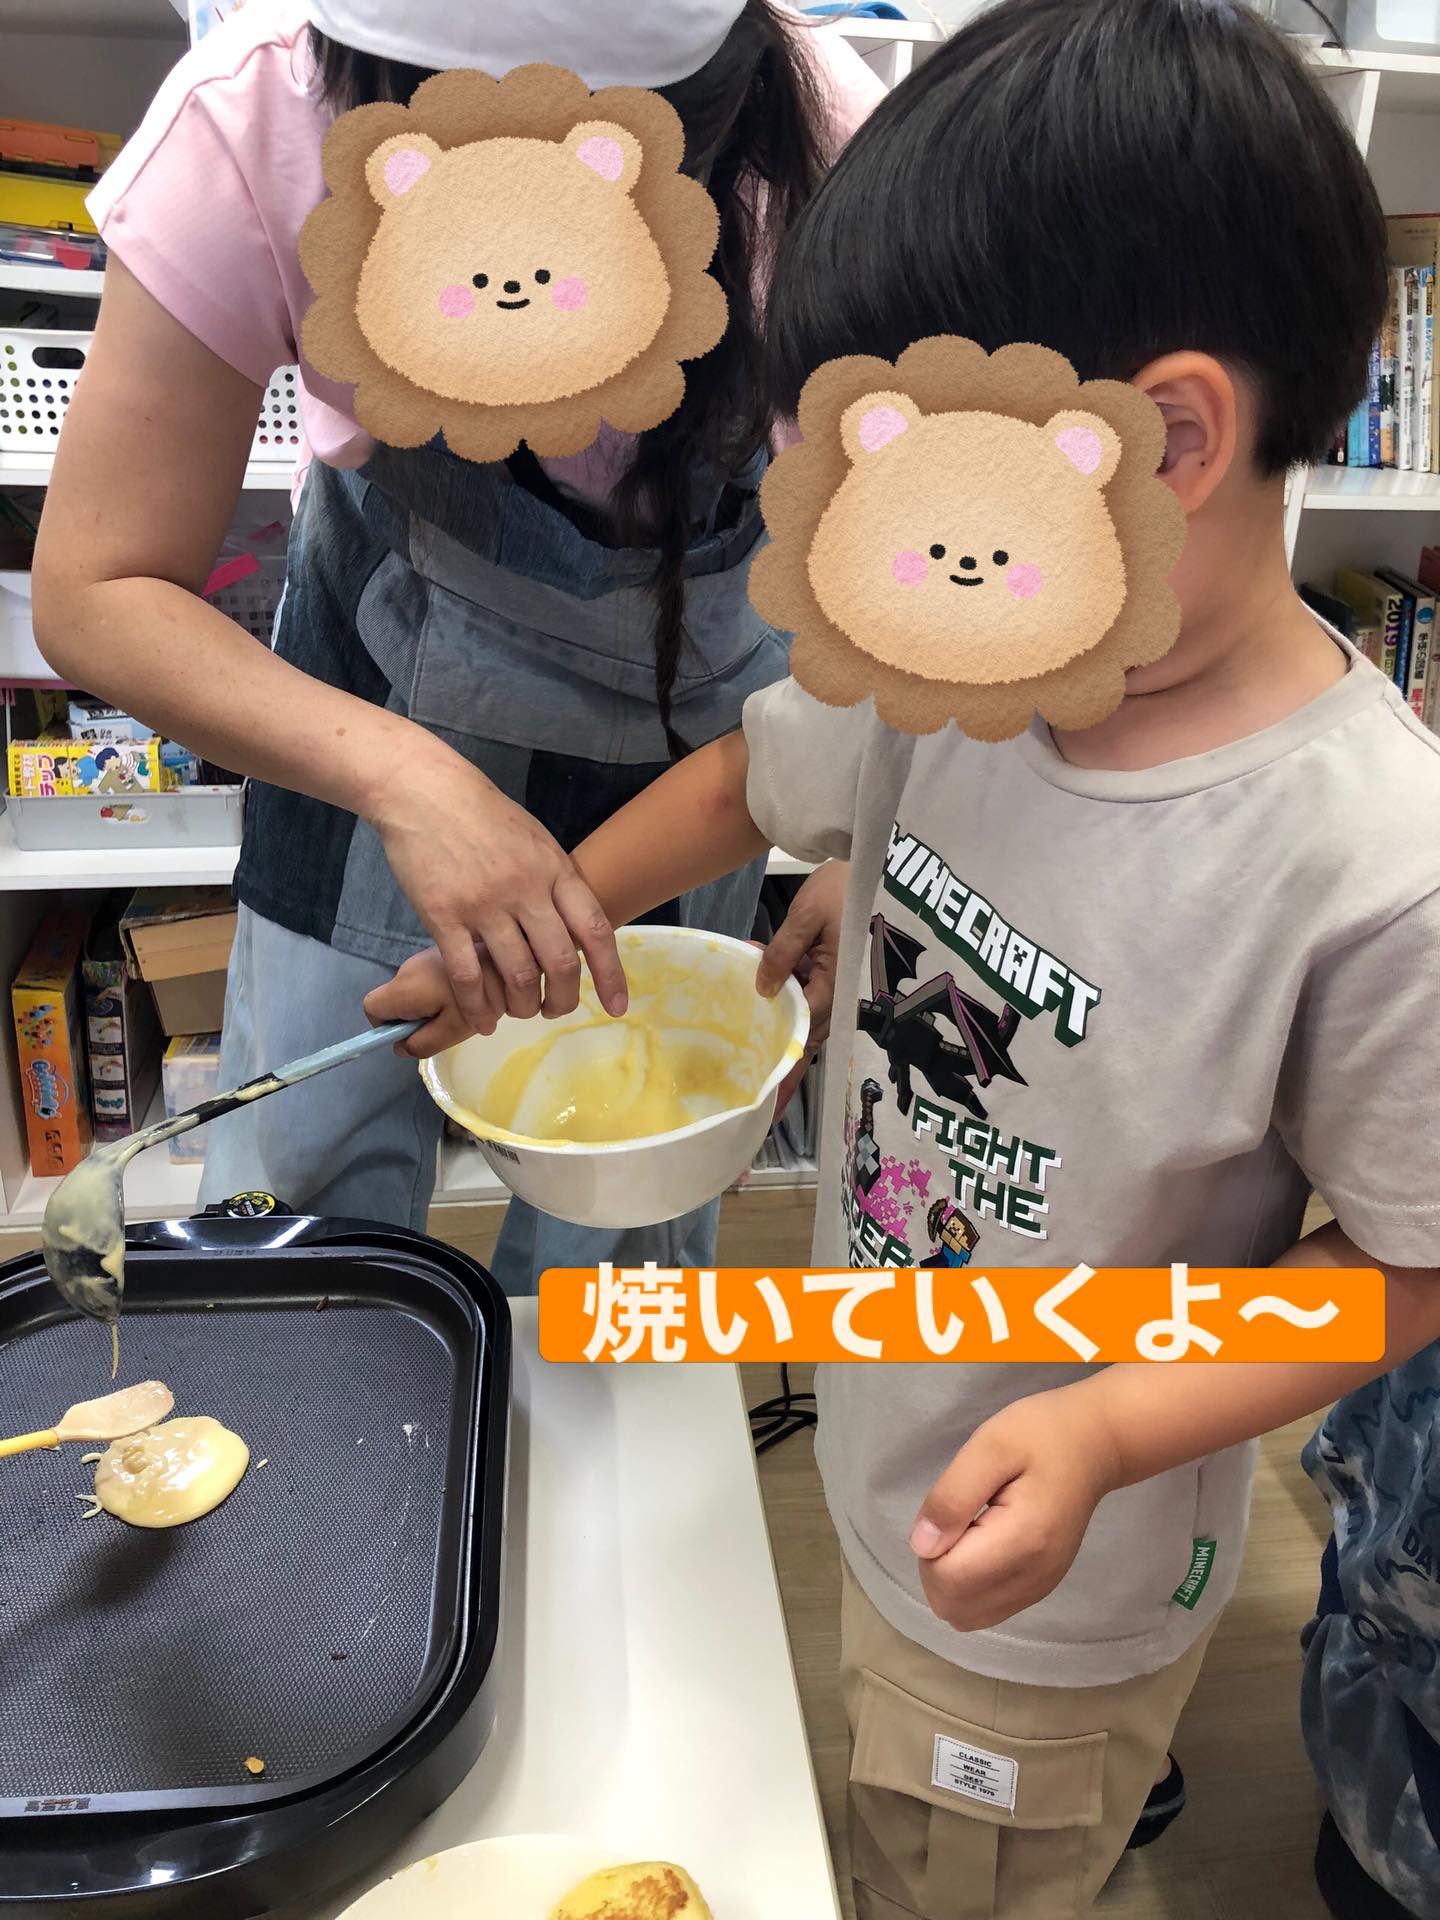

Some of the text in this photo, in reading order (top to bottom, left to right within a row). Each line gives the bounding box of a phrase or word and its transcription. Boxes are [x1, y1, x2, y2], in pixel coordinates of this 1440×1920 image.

[912, 1095, 1062, 1191] FIGHT
[948, 1158, 1049, 1240] THE
[1177, 1546, 1211, 1602] MINECRAFT
[959, 1752, 992, 1768] CLASSIC
[963, 1763, 986, 1776] WEAR
[954, 1778, 977, 1790] STYLE
[963, 1774, 984, 1785] BEST
